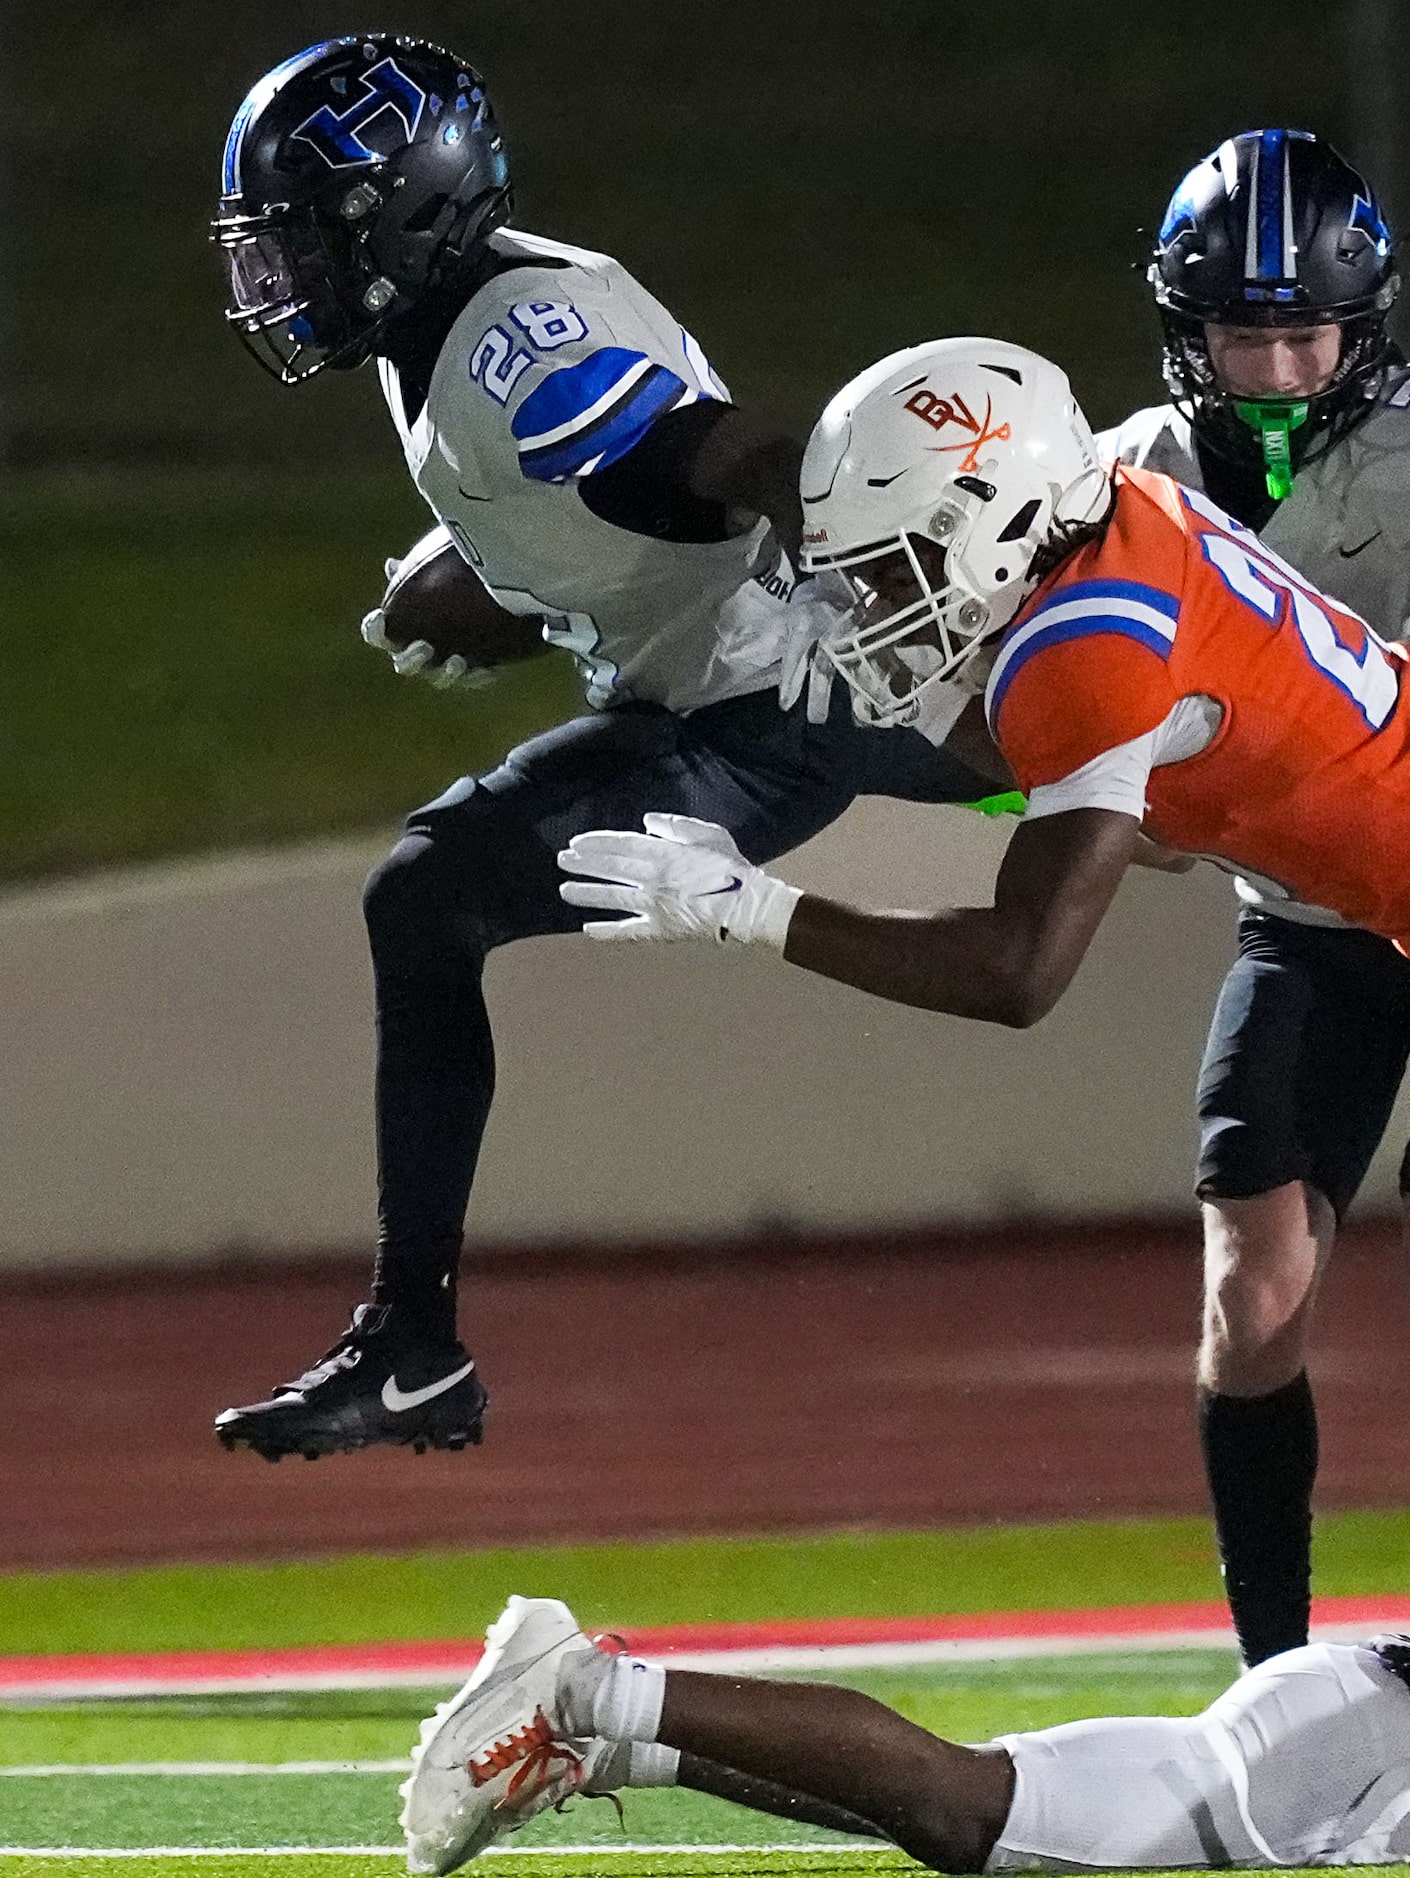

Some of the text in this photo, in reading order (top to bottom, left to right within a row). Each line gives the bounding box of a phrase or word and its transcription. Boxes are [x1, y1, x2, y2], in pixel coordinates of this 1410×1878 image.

[290, 56, 426, 169] H
[469, 301, 590, 409] 28
[903, 390, 981, 435] BV
